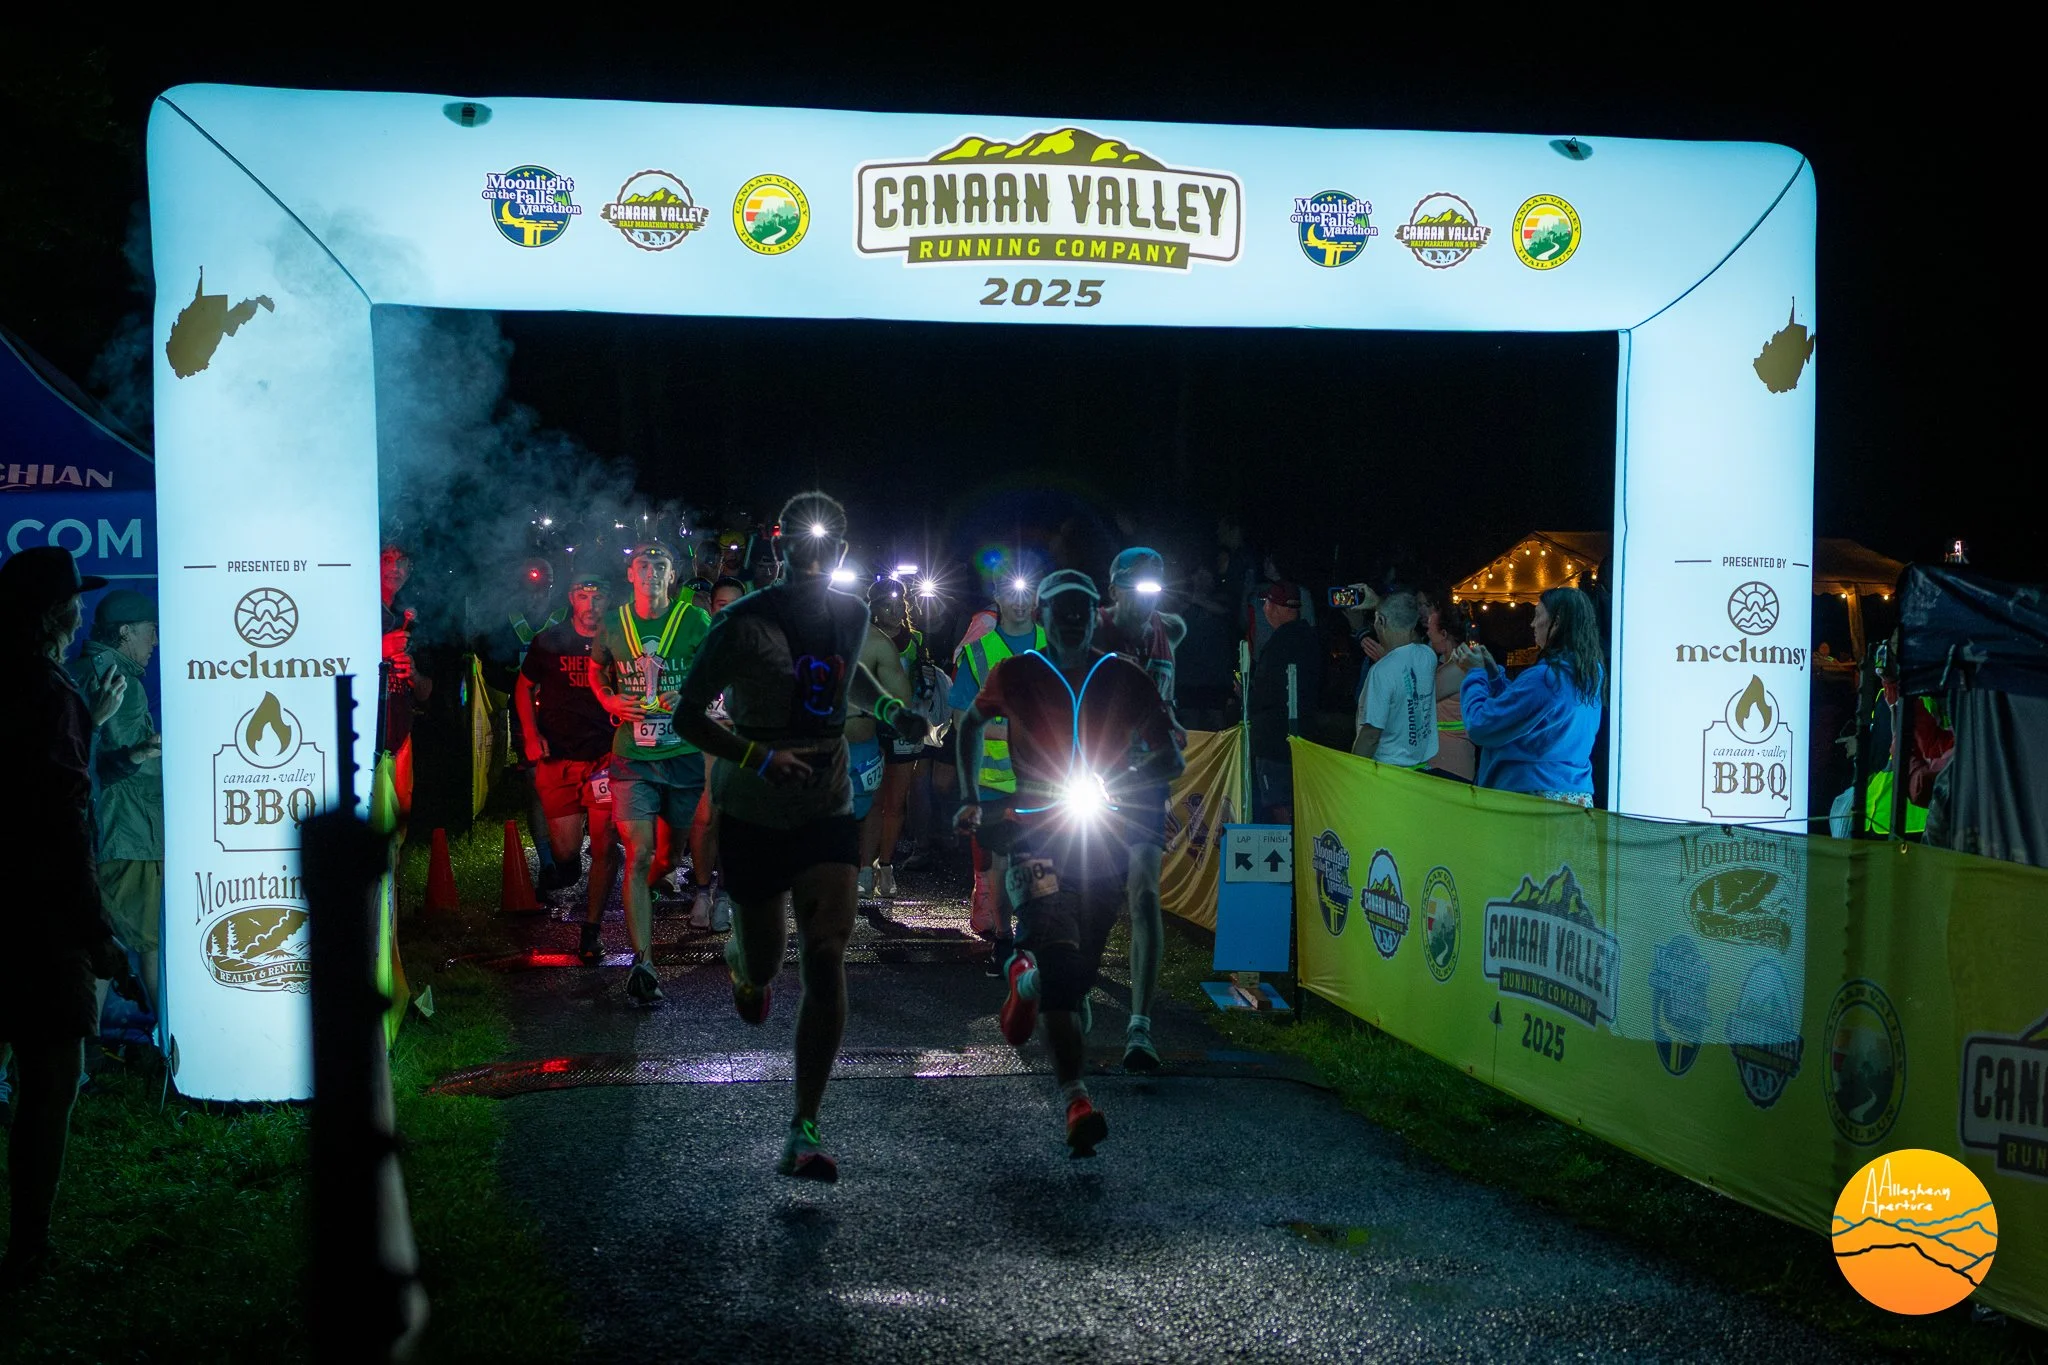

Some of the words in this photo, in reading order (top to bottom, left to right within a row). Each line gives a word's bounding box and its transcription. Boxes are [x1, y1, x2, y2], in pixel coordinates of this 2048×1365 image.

[488, 174, 574, 194] Moonlight
[482, 190, 497, 199] on
[499, 189, 516, 200] the
[515, 189, 554, 205] Falls
[735, 177, 772, 214] CANAAN
[776, 177, 808, 217] VALLEY
[873, 173, 1051, 229] CANAAN
[1068, 174, 1227, 237] VALLEY
[1295, 198, 1372, 217] Moonlight
[519, 202, 580, 216] Marathon
[610, 205, 656, 221] CANAAN
[660, 206, 703, 222] VALLEY
[1291, 214, 1303, 222] on
[1304, 213, 1320, 223] the
[1320, 213, 1354, 227] Falls
[1515, 197, 1547, 232] CANAAN
[1550, 197, 1579, 233] VALLEY
[635, 221, 667, 229] MARATHON
[1323, 226, 1378, 238] Marathon
[1403, 226, 1445, 240] CANAAN
[1448, 226, 1486, 241] VALLEY
[740, 229, 775, 253] TRAIL
[778, 231, 802, 251] RUN
[919, 238, 1040, 258] RUNNING
[1055, 238, 1177, 264] COMPANY
[1518, 246, 1548, 268] TRAIL
[1550, 247, 1573, 266] RUN
[979, 278, 1106, 307] 2025
[227, 560, 290, 573] PRESENTED
[293, 560, 307, 572] BY
[1722, 556, 1774, 568] PRESENTED
[1777, 558, 1787, 569] BY
[187, 650, 350, 680] mcclumsy
[1676, 637, 1807, 671] mcclumsy
[1713, 747, 1755, 757] canaan
[1761, 745, 1788, 762] valley
[223, 773, 270, 784] canaan
[279, 768, 316, 786] valley
[1712, 761, 1789, 801] BBQ
[223, 787, 317, 829] BBQ
[1236, 835, 1251, 843] LAP
[1263, 835, 1288, 843] FINISH
[1679, 834, 1777, 884] Mountain
[194, 865, 306, 926] Mountain
[1364, 891, 1386, 916] CANAAN
[1387, 900, 1408, 924] VALLEY
[1489, 913, 1550, 968] CANAAN
[1556, 925, 1616, 998] VALLEY
[220, 971, 257, 983] REALTY
[259, 970, 266, 978] &
[1502, 971, 1544, 997] RUNNING
[1547, 982, 1593, 1018] COMPANY
[1522, 1013, 1566, 1062] 2025
[1973, 1055, 2048, 1128] CAN
